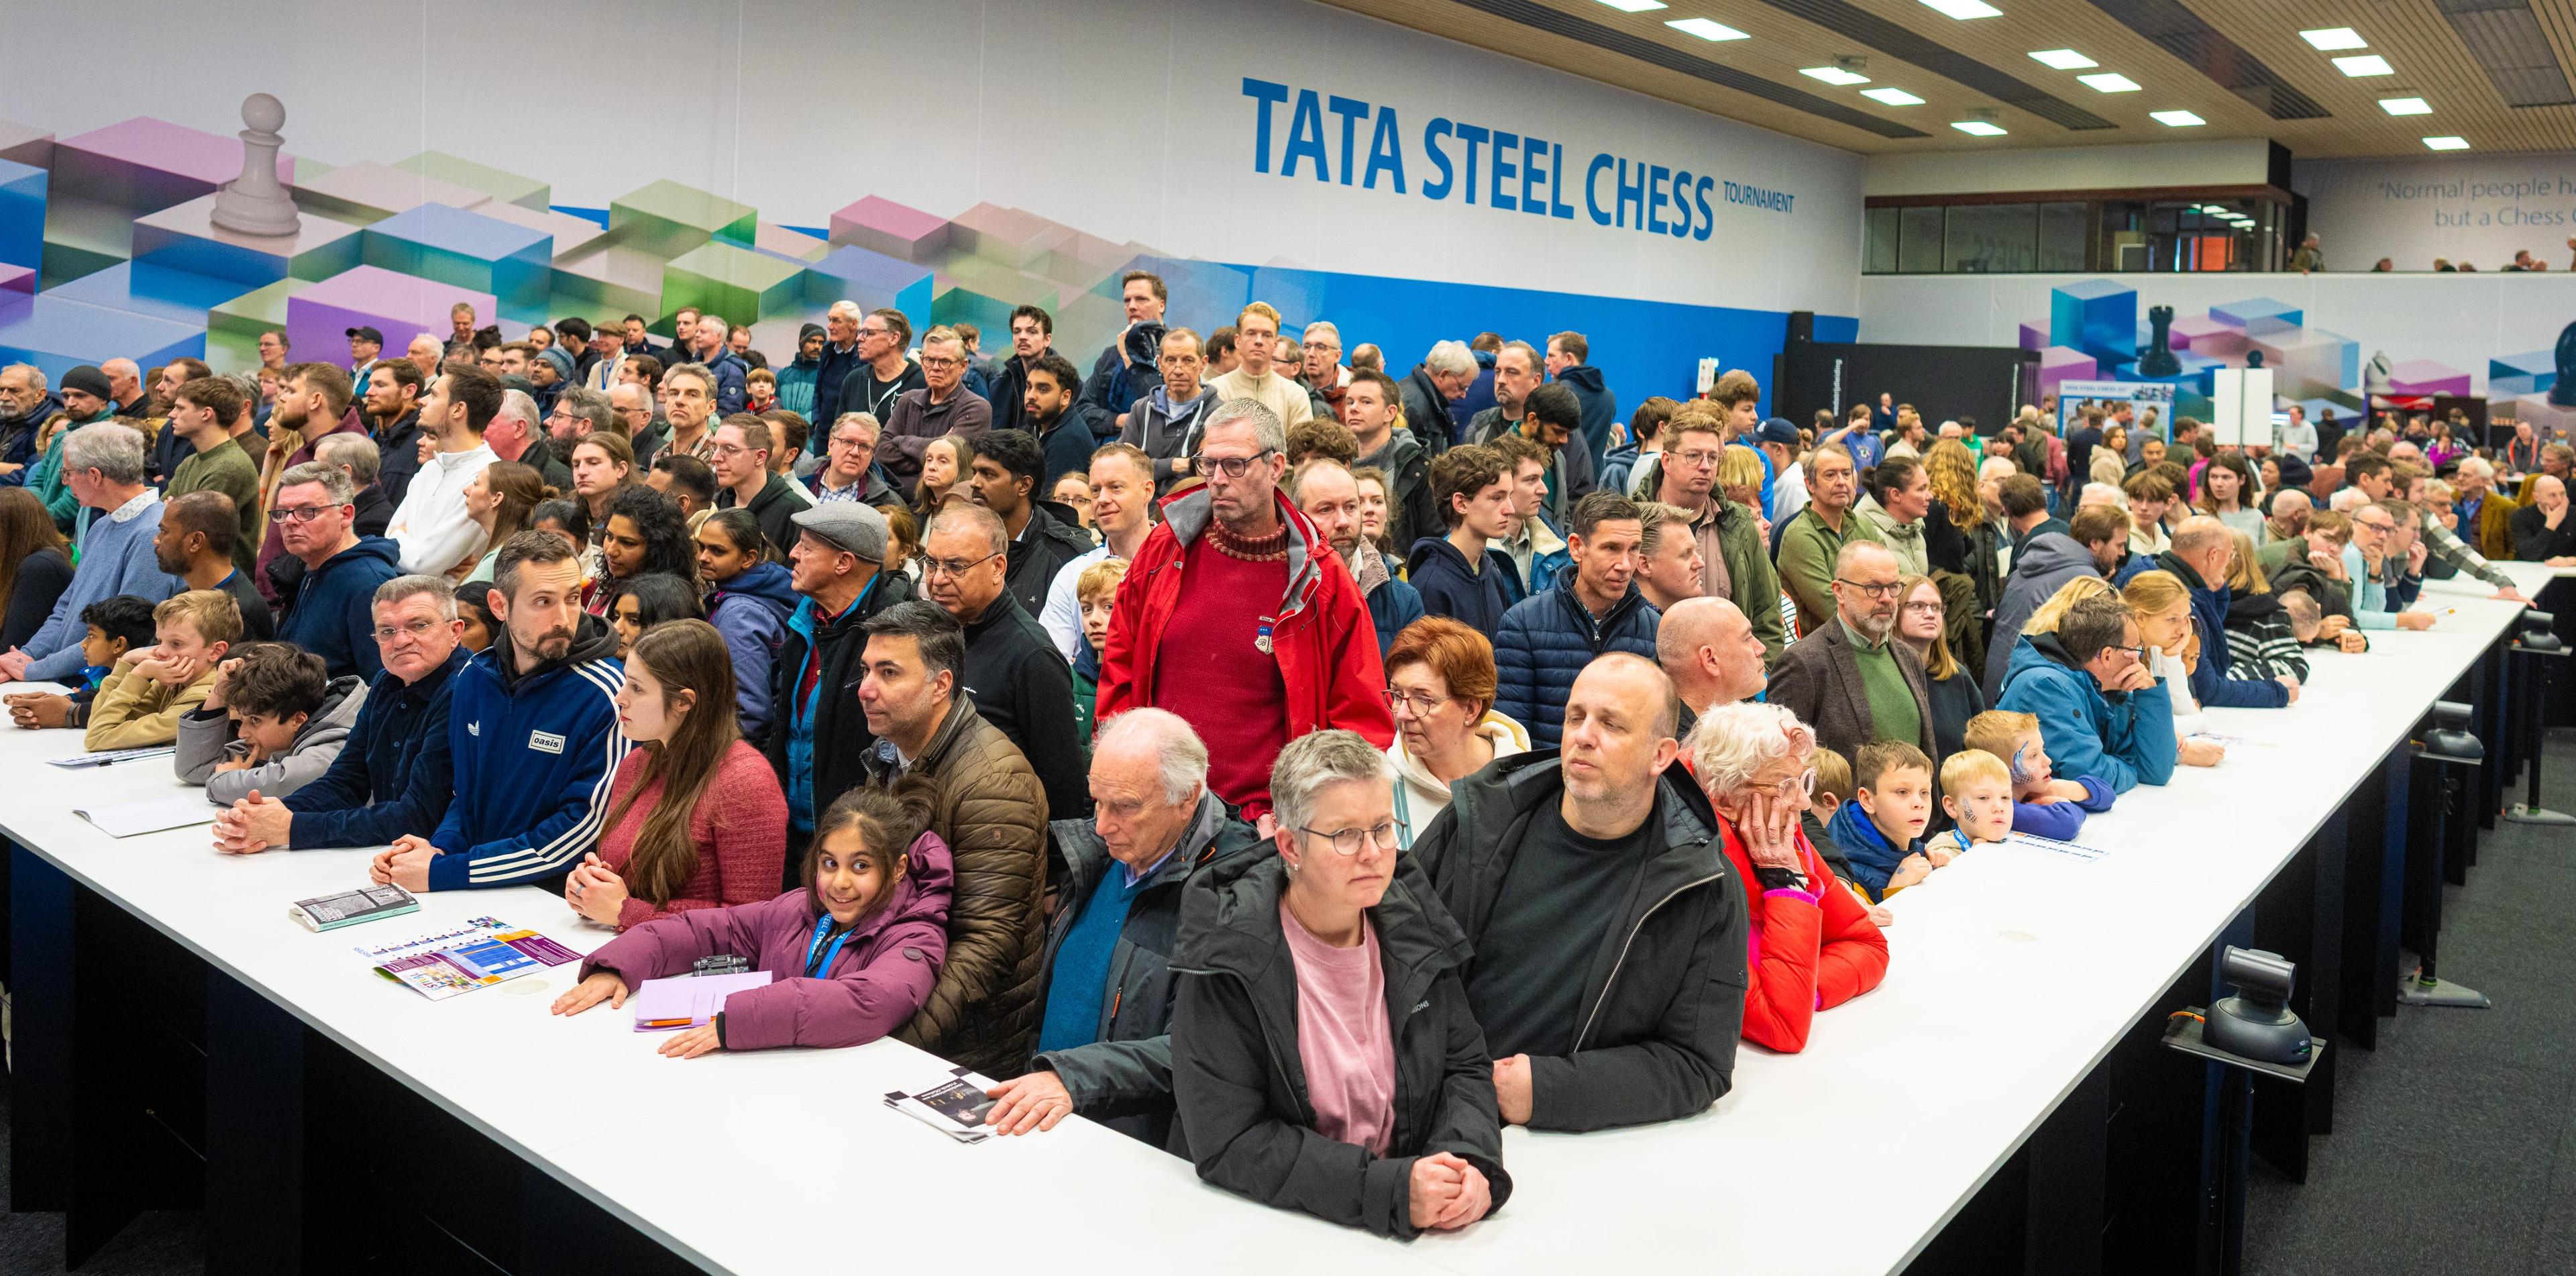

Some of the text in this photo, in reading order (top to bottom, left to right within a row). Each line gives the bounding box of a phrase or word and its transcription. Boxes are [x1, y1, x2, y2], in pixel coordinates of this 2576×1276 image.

[1242, 77, 1794, 242] TATA STEEL CHESS TOURNAMENT
[2471, 176, 2551, 201] people
[2435, 207, 2471, 227] but
[2478, 211, 2490, 226] a
[2497, 205, 2565, 227] Chess
[534, 737, 559, 748] oasis
[821, 913, 832, 929] TEEL
